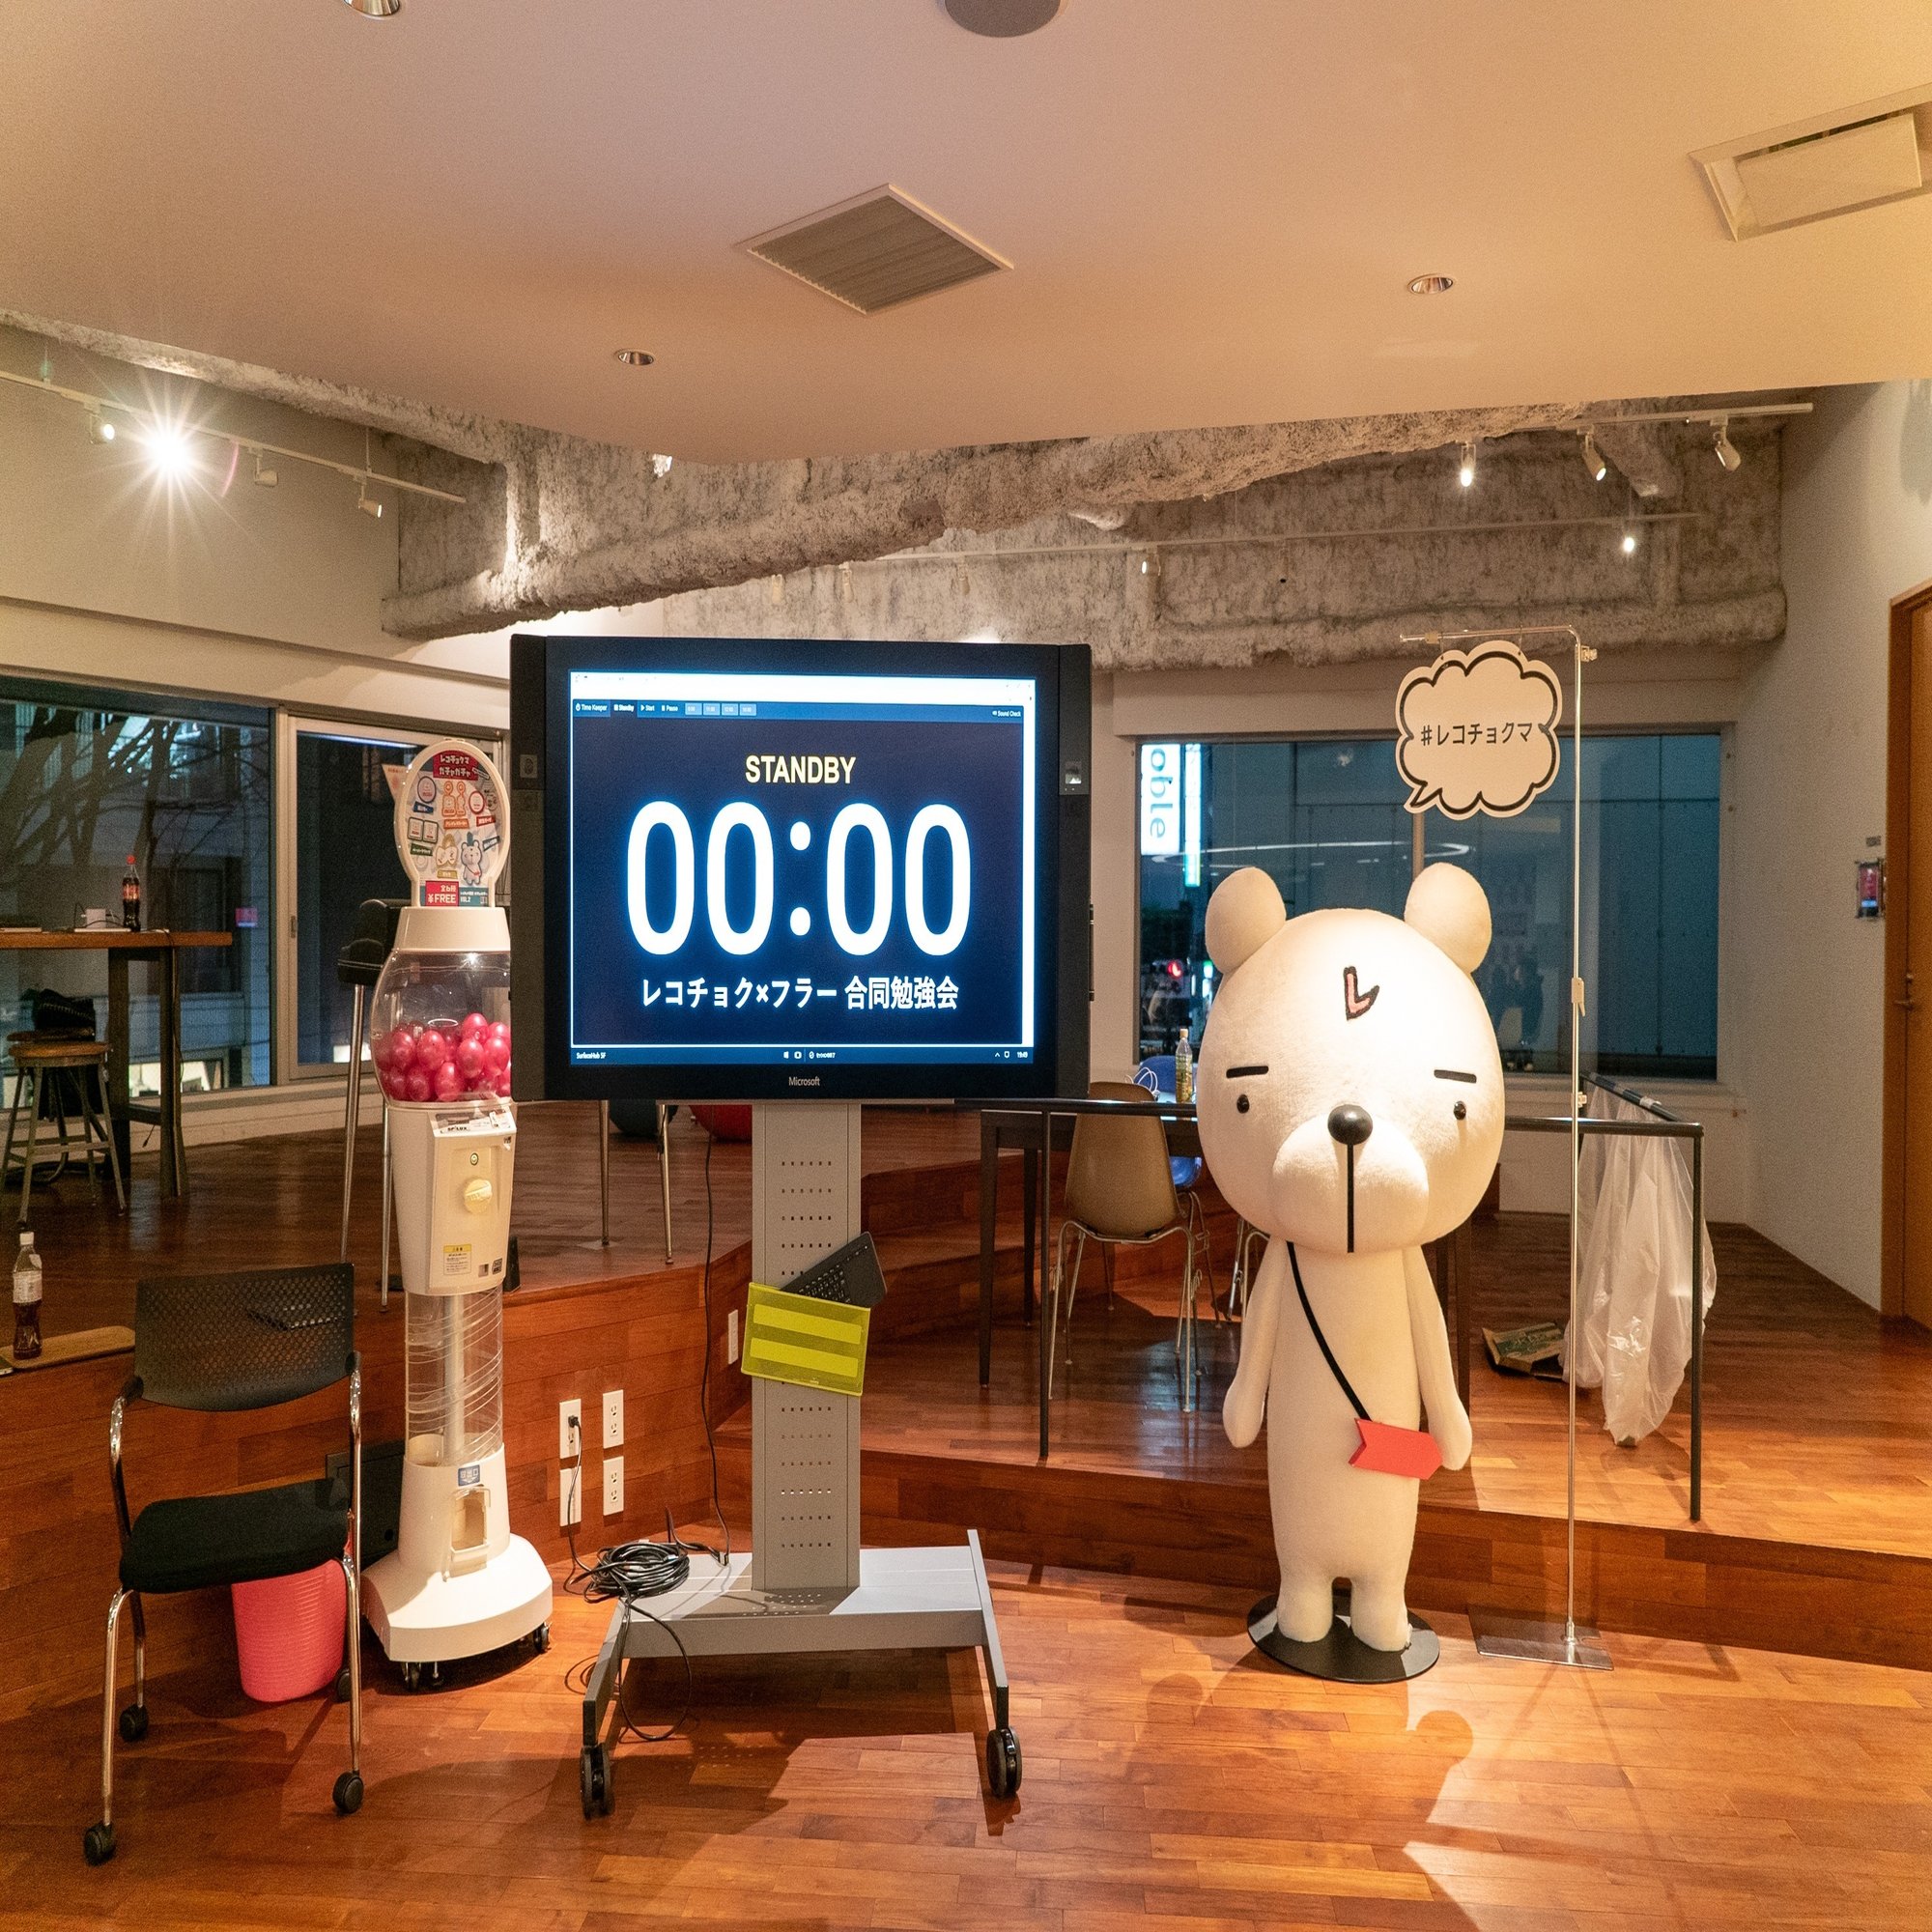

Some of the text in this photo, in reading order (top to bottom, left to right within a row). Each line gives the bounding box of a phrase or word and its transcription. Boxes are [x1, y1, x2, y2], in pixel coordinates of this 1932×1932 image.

[1421, 722, 1533, 747] #レコチョクマ
[746, 754, 857, 784] STANDBY
[628, 801, 971, 956] 00:00
[428, 893, 457, 904] ¥FREE
[641, 975, 959, 1010] レコチョク×フラー 合同勉強会
[788, 1075, 820, 1087] Microsoft
